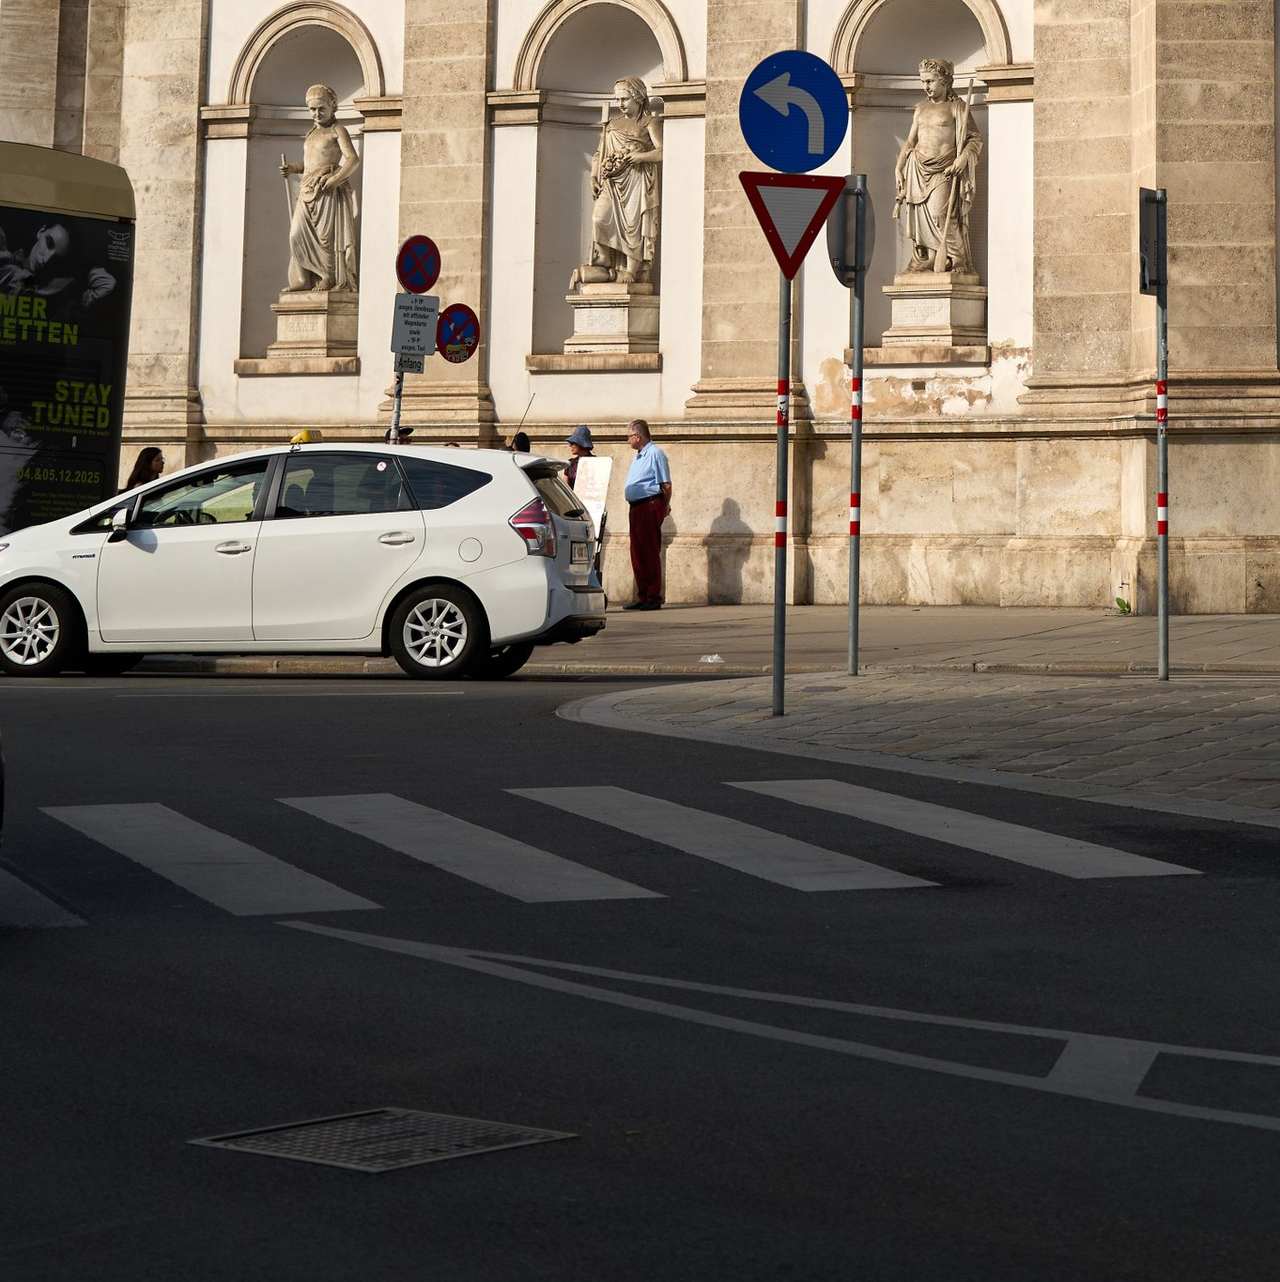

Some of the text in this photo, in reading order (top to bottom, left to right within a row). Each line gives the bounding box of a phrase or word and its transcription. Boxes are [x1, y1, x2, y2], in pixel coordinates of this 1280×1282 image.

[0, 316, 79, 346] ETTEN
[398, 357, 422, 371] Anfang
[56, 379, 113, 406] STAY
[32, 401, 110, 428] TUNED
[17, 466, 101, 484] 04.&05.12.2025
